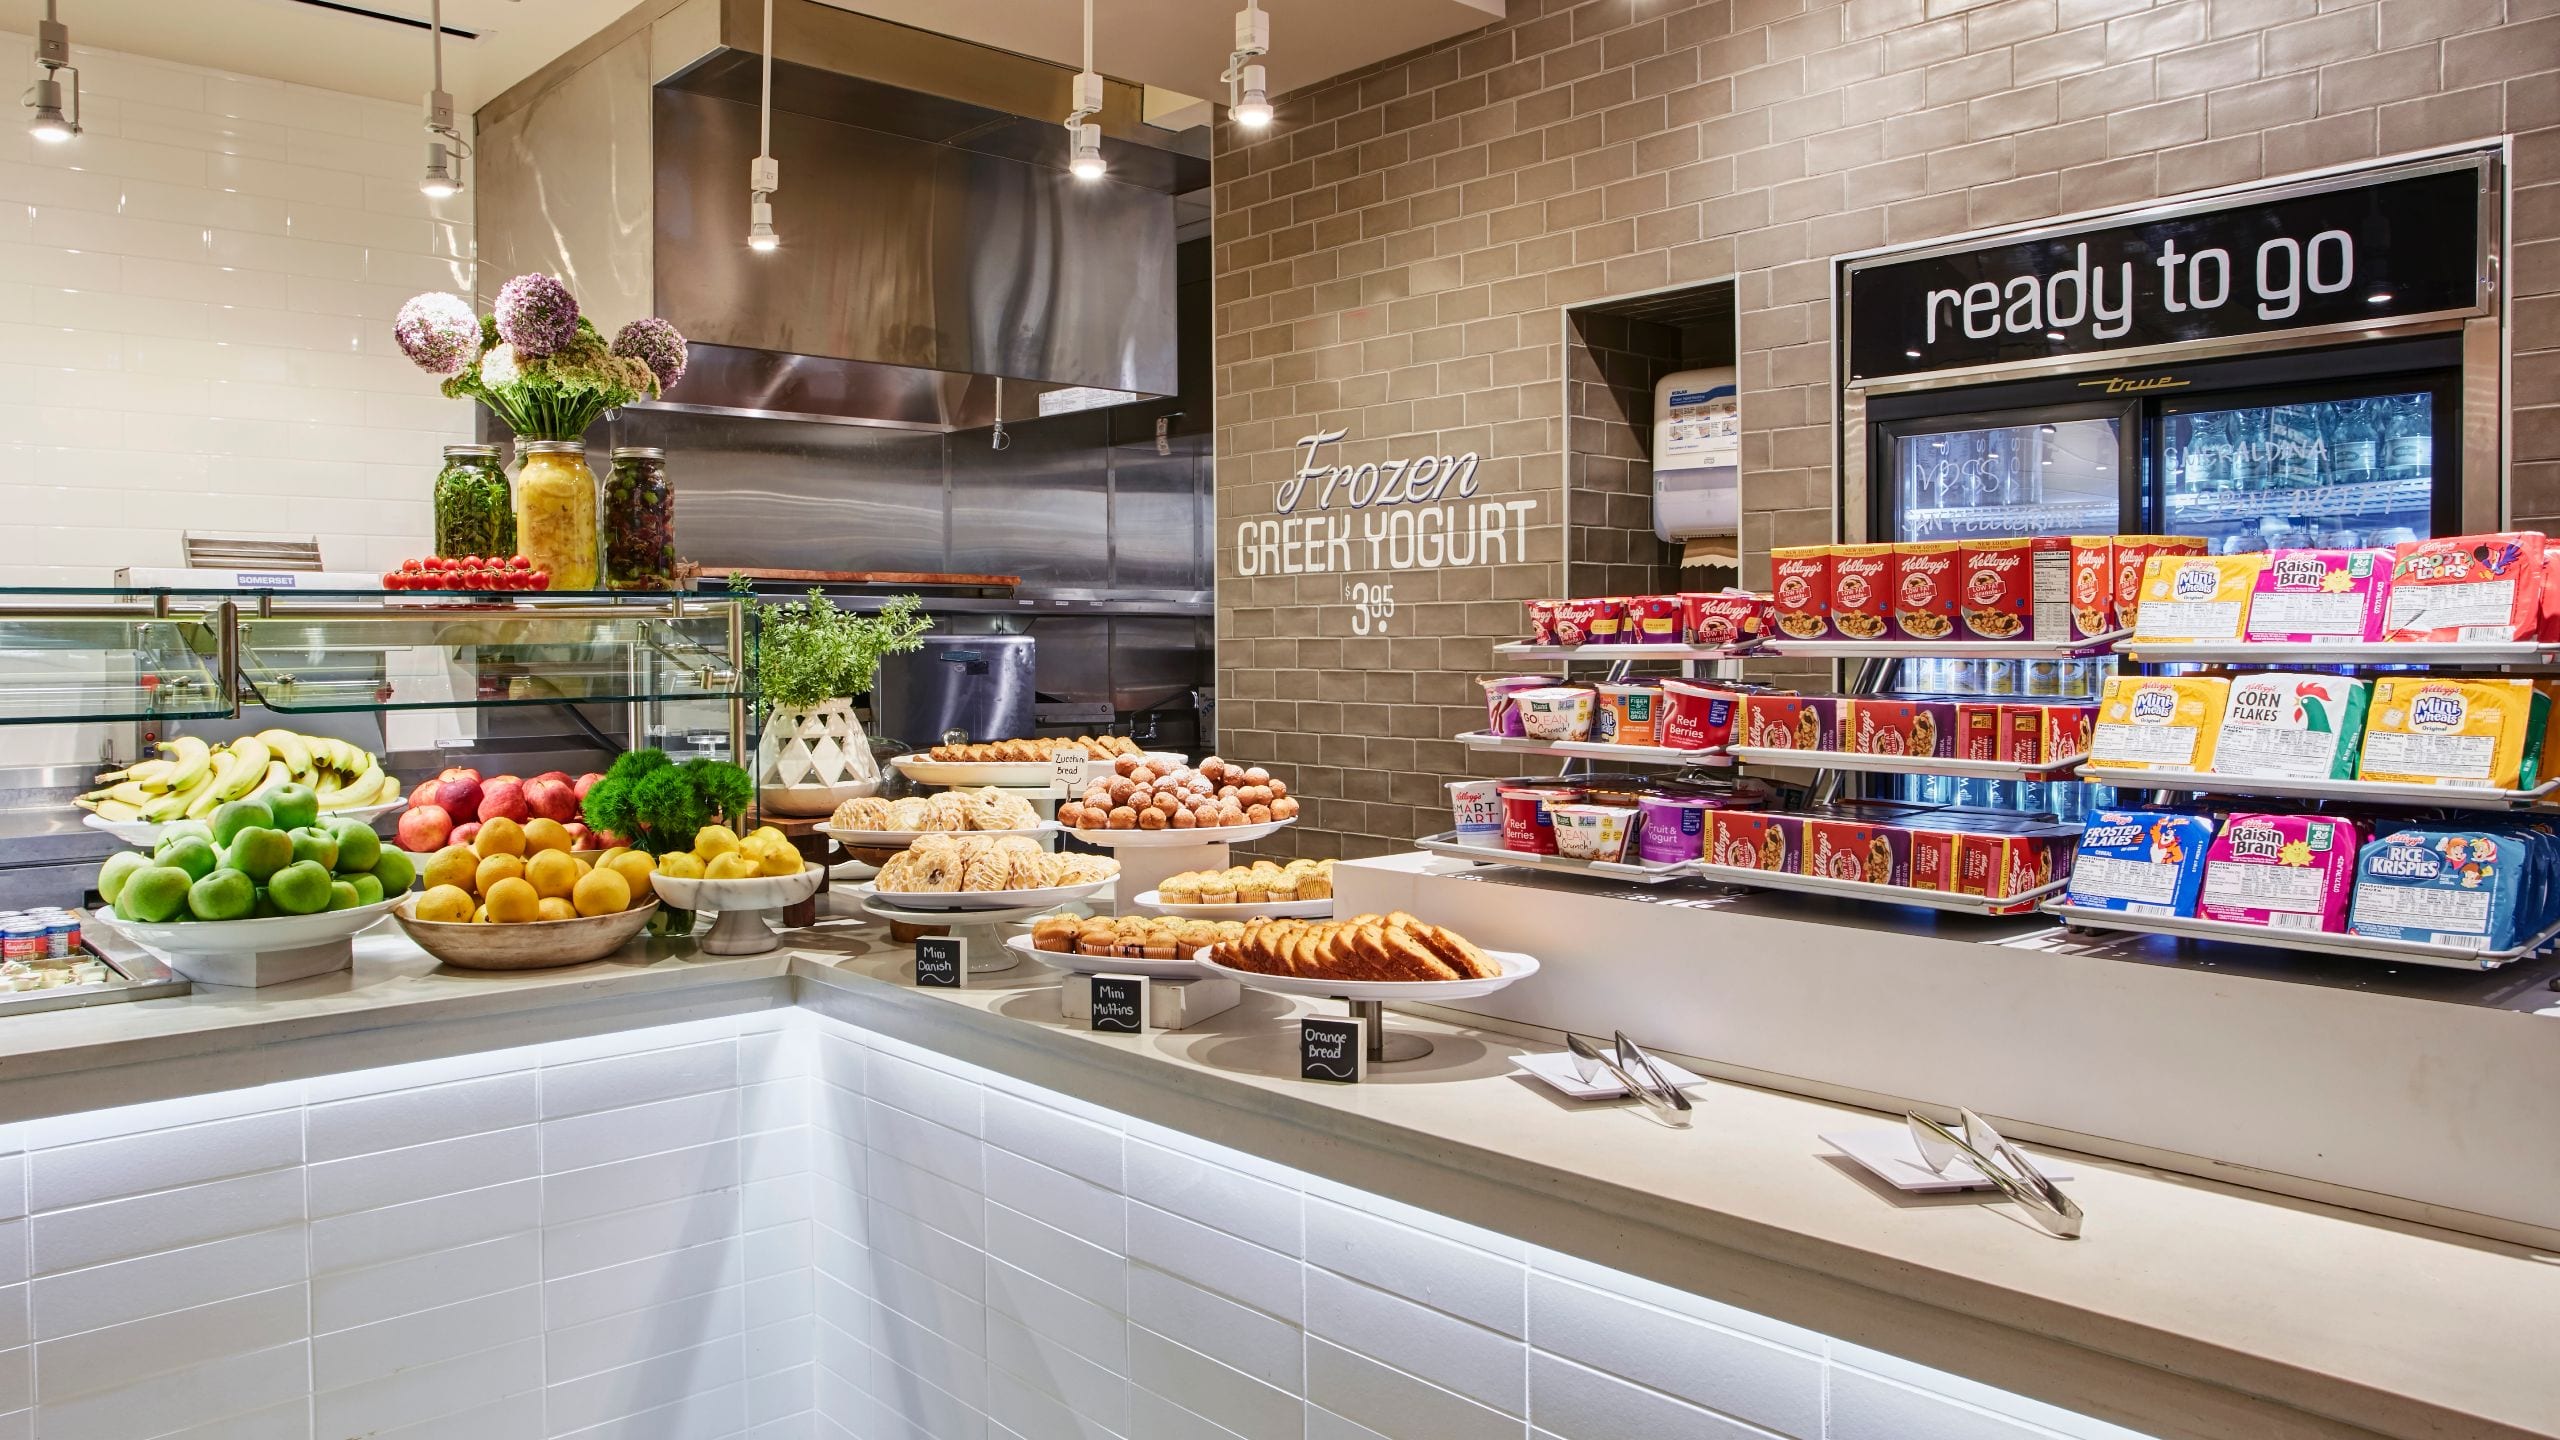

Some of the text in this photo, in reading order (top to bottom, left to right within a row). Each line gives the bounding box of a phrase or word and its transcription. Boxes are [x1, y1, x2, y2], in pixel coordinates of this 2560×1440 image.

[1926, 230, 2353, 344] ready to go
[2092, 377, 2184, 392] true
[1276, 427, 1480, 515] Frozen
[1916, 460, 2000, 493] VOSS
[1237, 500, 1537, 576] GREEK YOGURT
[1902, 556, 1950, 574] Kellogg's
[1969, 552, 2020, 571] Kellogg's
[2077, 550, 2106, 569] Kellogg's
[2119, 548, 2145, 567] Kellogg's
[2408, 551, 2465, 572] FROOT
[1779, 560, 1823, 577] Kellogg's
[1838, 558, 1883, 576] Kellogg's
[2275, 561, 2325, 575] Raisin
[2415, 564, 2469, 580] LOOPS
[239, 576, 293, 585] SOMERSET
[2180, 571, 2215, 585] Mini
[2279, 573, 2318, 586] Bran
[2178, 583, 2213, 595] Wheats
[1701, 600, 1752, 620] Kellogg's
[2421, 685, 2459, 696] Kellogg's
[2137, 692, 2172, 708] Mini
[2236, 691, 2281, 708] CORN
[2415, 696, 2461, 714] Mini
[2135, 706, 2170, 717] Wheats
[2233, 707, 2278, 721] FLAKES
[2414, 712, 2459, 725] Wheats
[1677, 714, 1697, 727] Red
[1670, 723, 1704, 738] Berries
[1057, 765, 1078, 775] Bread
[1456, 792, 1482, 803] Kellogg's
[1510, 819, 1526, 829] Red
[1648, 823, 1677, 835] Fruit &
[2084, 825, 2142, 838] FROSTED
[1507, 828, 1534, 840] Berries
[1648, 831, 1677, 843] Yogurt
[2231, 828, 2283, 844] Raisin
[2385, 834, 2425, 846] Kellogg's
[2082, 836, 2133, 848] FLAKES
[2235, 841, 2277, 857] Bran
[2390, 847, 2422, 862] RICE
[2370, 858, 2438, 878] KRISPIES
[923, 946, 946, 959] Mini
[918, 960, 952, 972] Danish
[1100, 985, 1124, 999] Mini
[1093, 1003, 1134, 1016] Muffins
[1305, 1028, 1347, 1050] Orange
[1309, 1044, 1342, 1059] Bread
